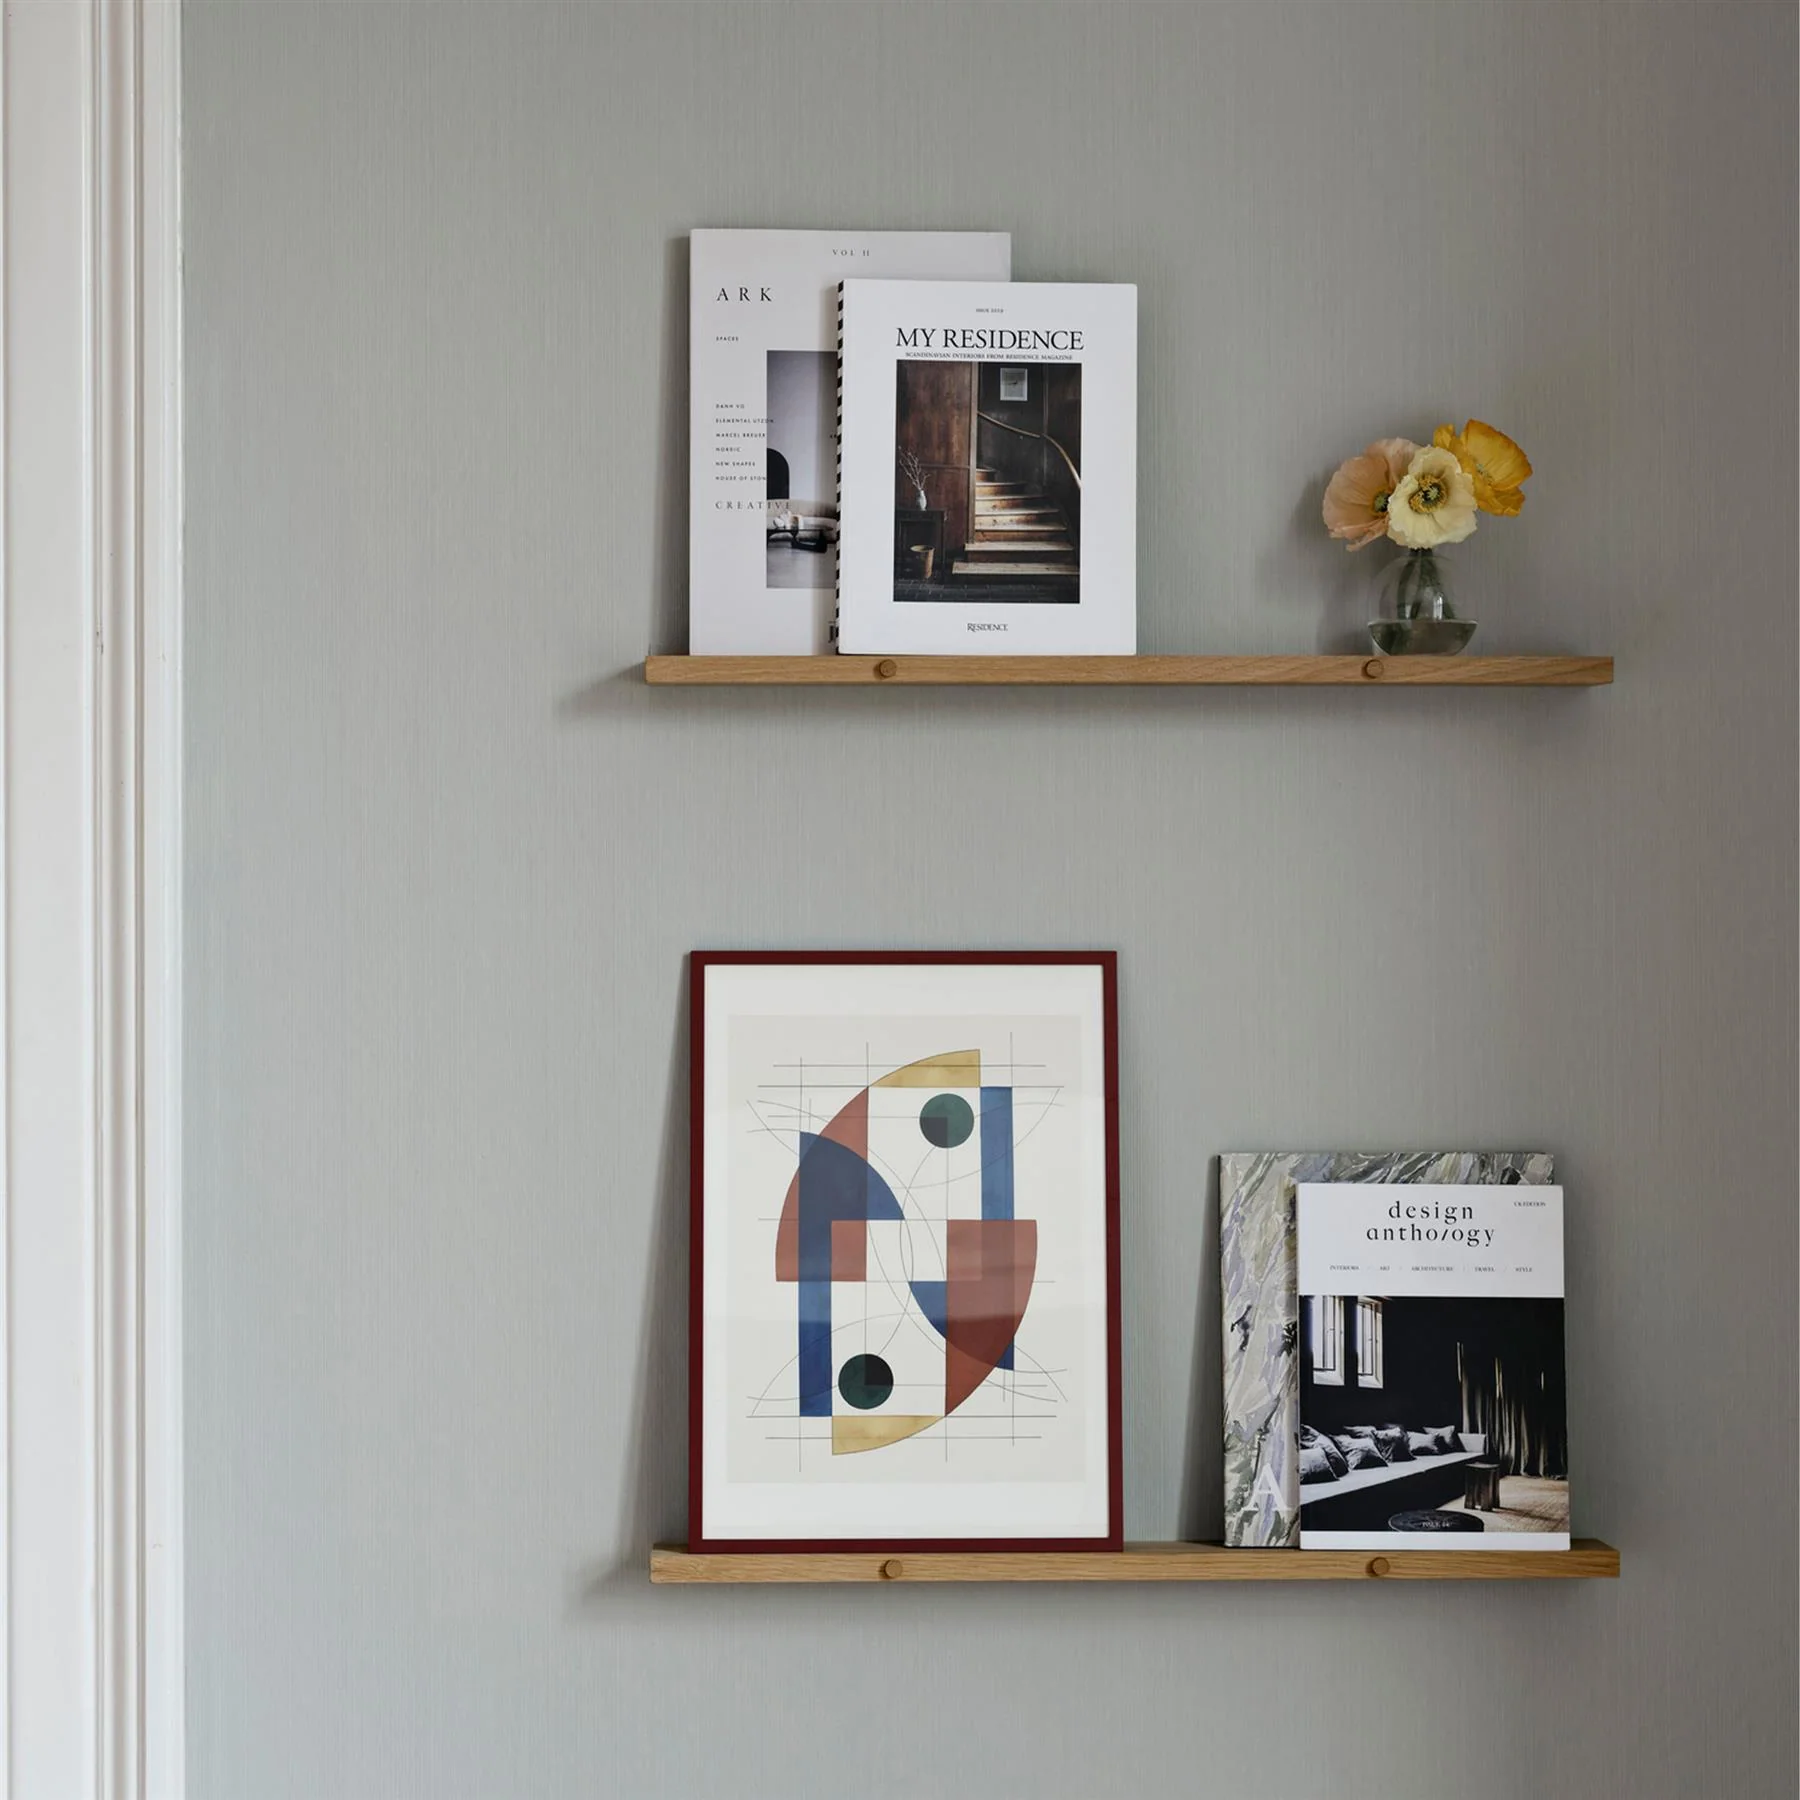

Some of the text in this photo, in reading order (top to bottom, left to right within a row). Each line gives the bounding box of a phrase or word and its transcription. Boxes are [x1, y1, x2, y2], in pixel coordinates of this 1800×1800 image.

[716, 287, 772, 302] ARK
[896, 327, 1084, 351] MY RESIDENCE
[715, 501, 791, 510] CREATIVE
[967, 622, 1008, 632] RESIDENCE
[1388, 1200, 1474, 1226] design
[1366, 1224, 1495, 1247] anthology
[1241, 1463, 1292, 1511] A
